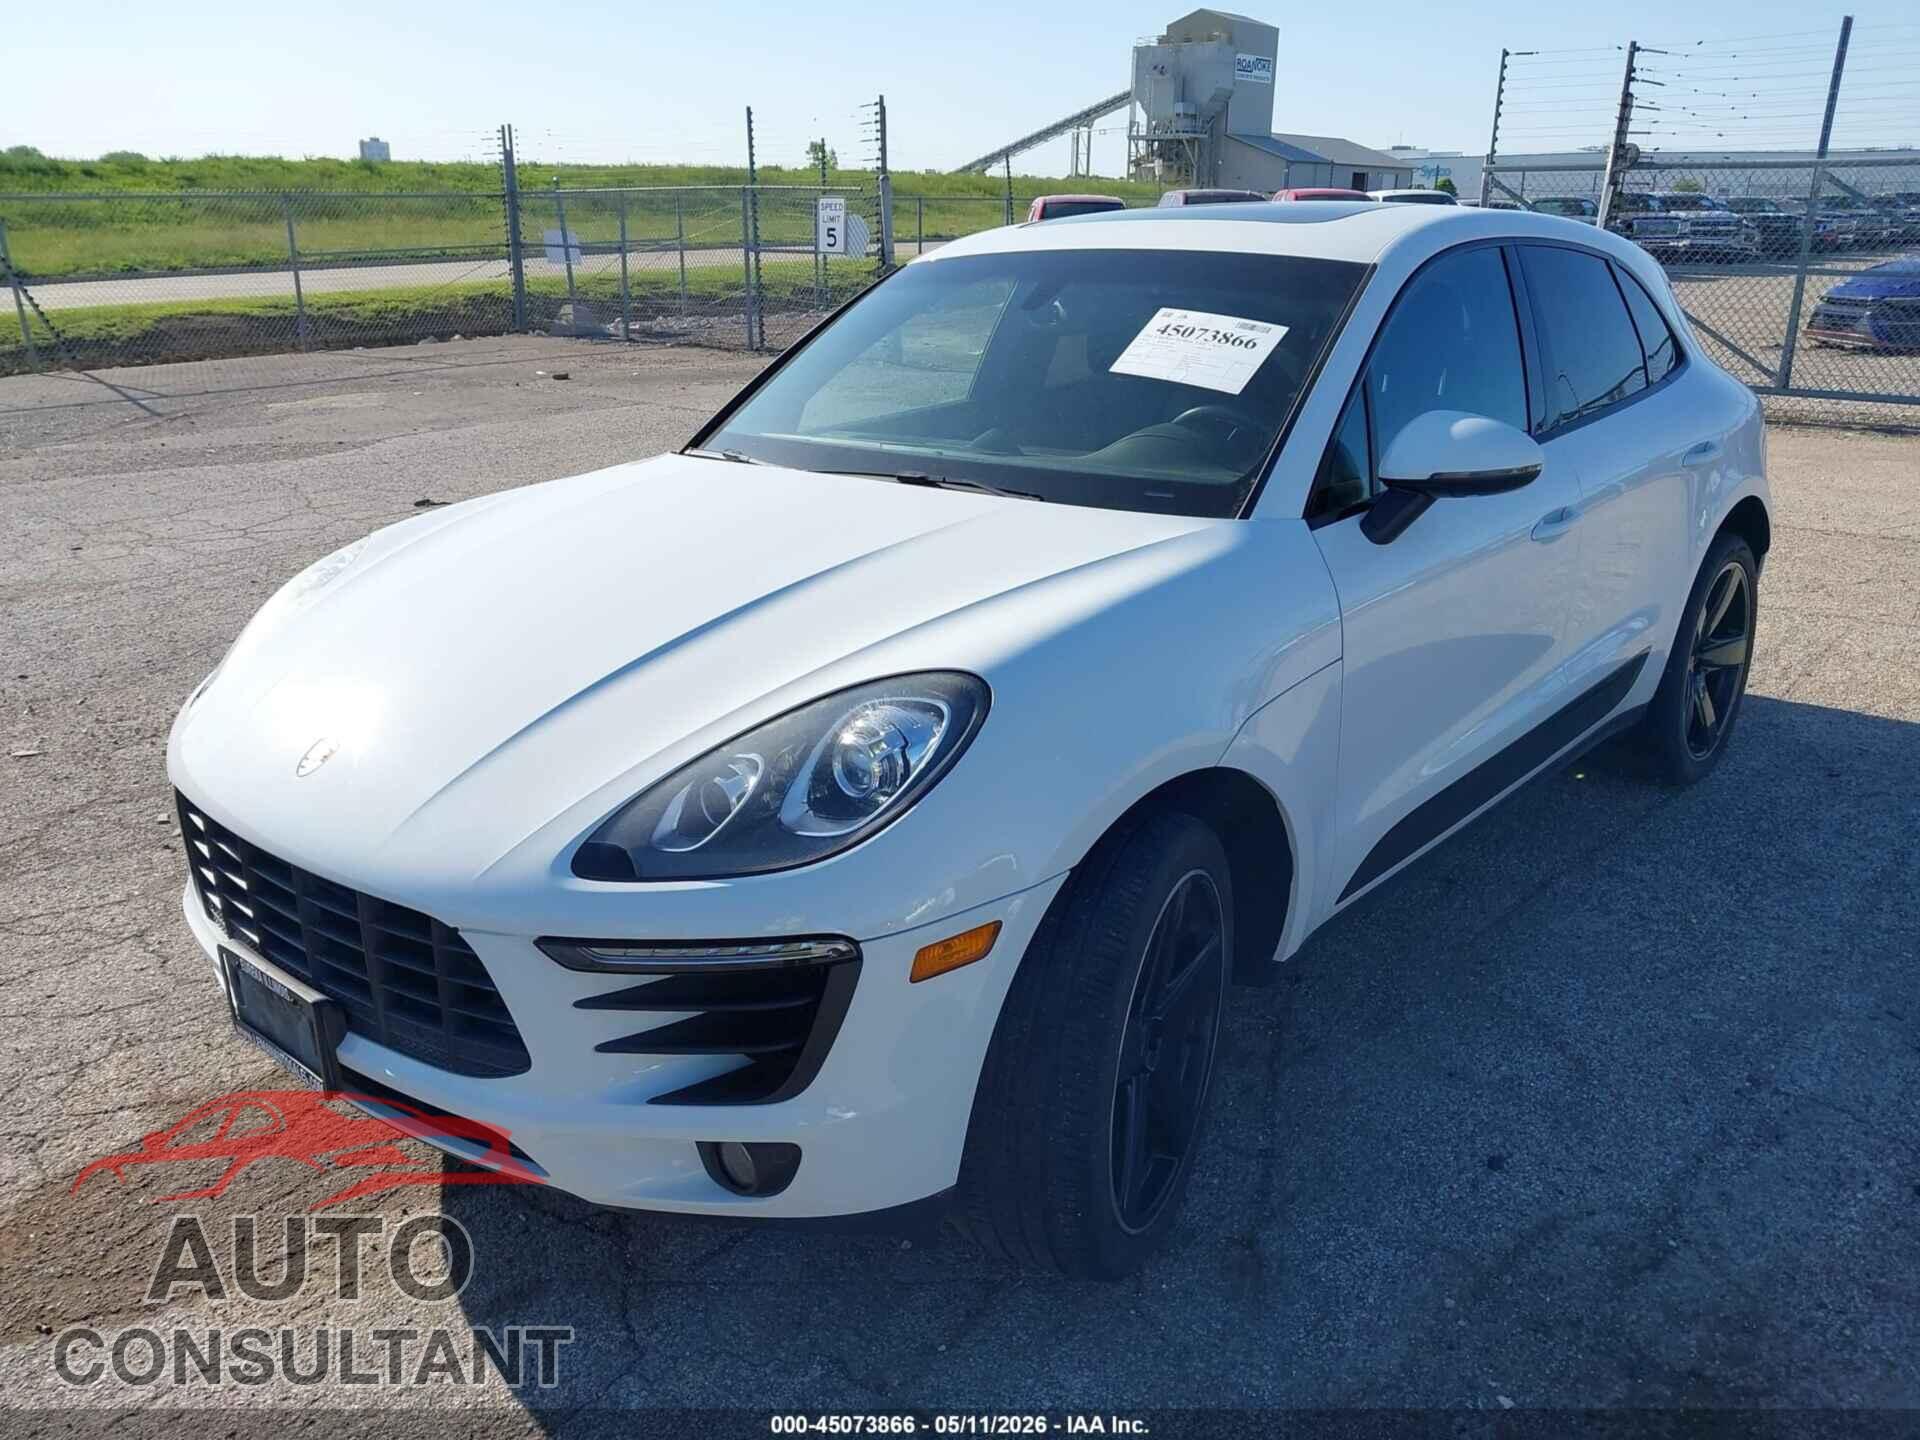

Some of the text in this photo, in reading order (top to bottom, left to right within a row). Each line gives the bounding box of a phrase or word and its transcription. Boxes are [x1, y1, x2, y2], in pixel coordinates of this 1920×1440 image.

[1237, 58, 1271, 72] ROANOKE
[821, 202, 843, 211] SPEED
[822, 215, 841, 224] LIMIT
[826, 227, 837, 248] 5
[1156, 323, 1258, 351] 45073866
